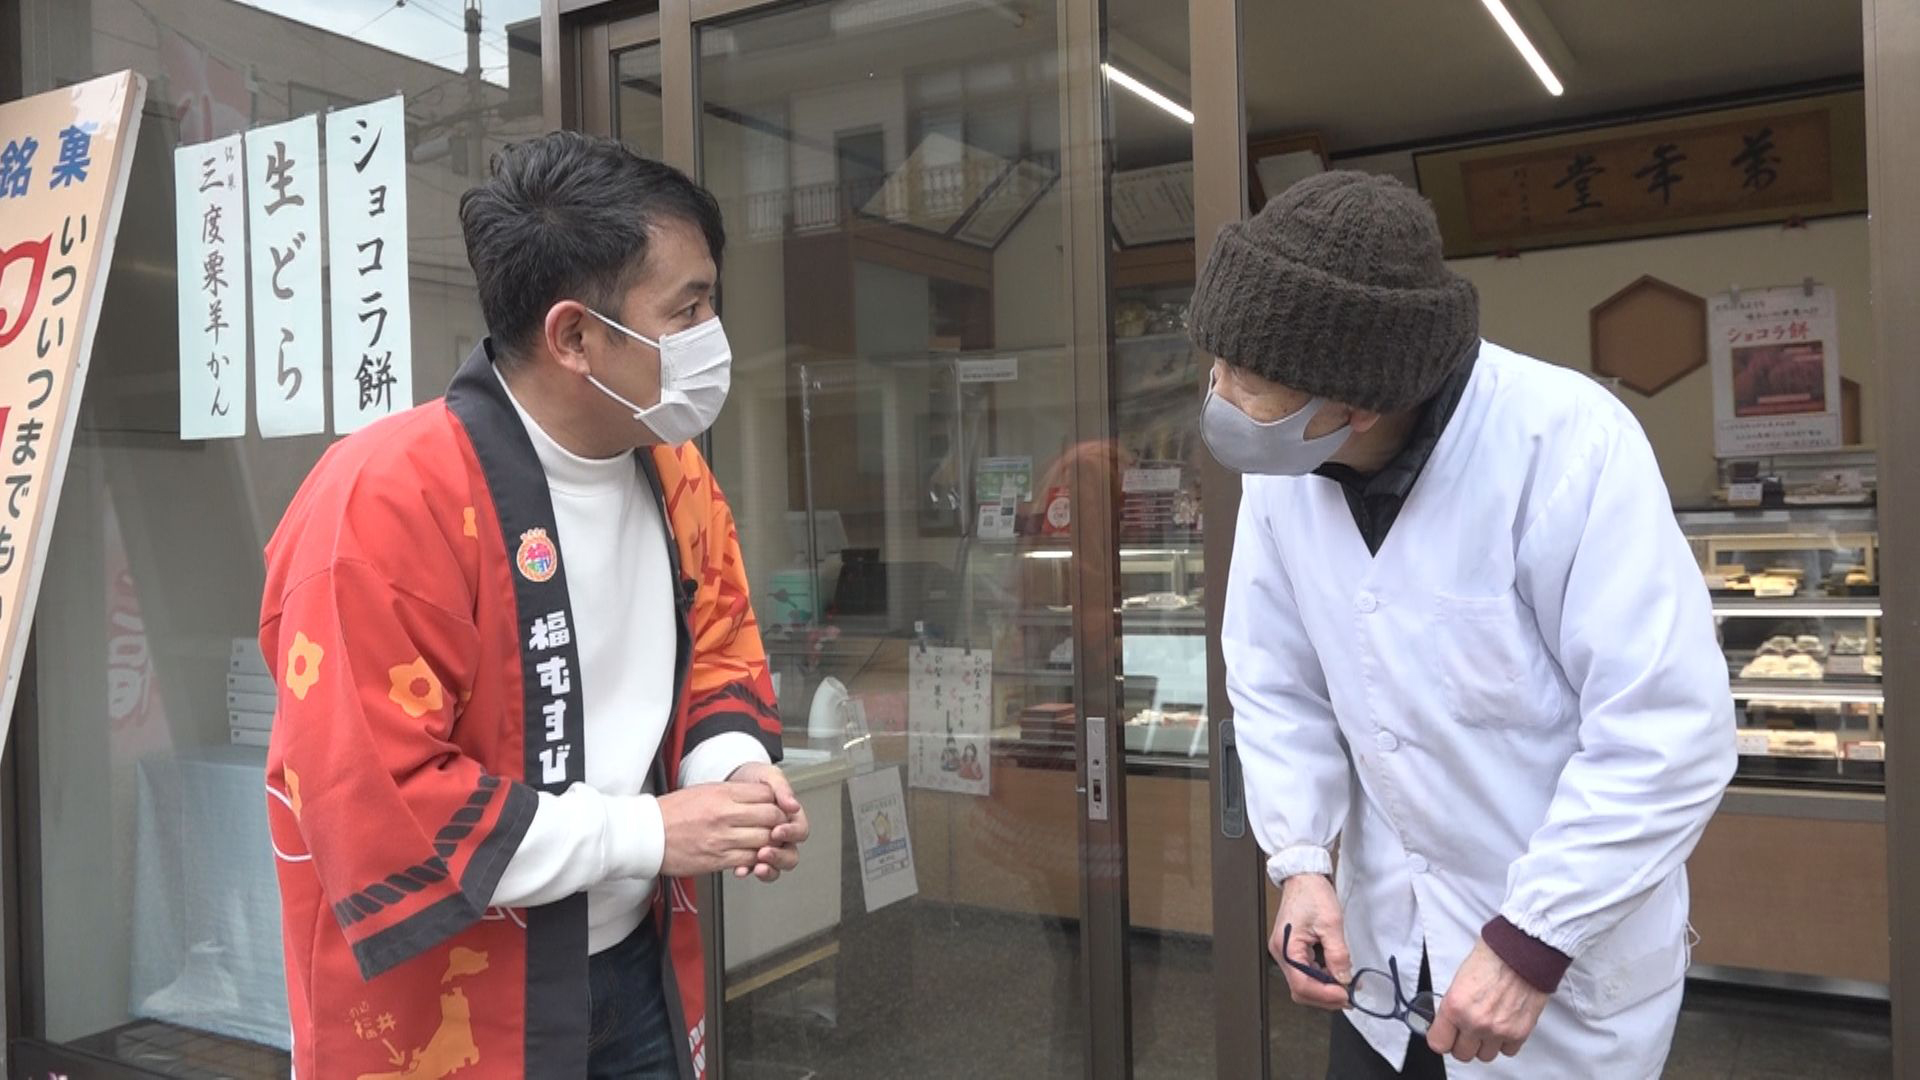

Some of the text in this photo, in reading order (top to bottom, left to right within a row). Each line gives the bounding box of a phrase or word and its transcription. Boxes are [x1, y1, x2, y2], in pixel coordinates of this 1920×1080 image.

[0, 122, 98, 198] 銘菓
[199, 156, 230, 417] 三度栗羊かん
[264, 141, 306, 401] 生どら
[351, 120, 398, 413] ショコラ餅
[0, 214, 87, 619] いついつまでも
[529, 610, 571, 785] 福むすび
